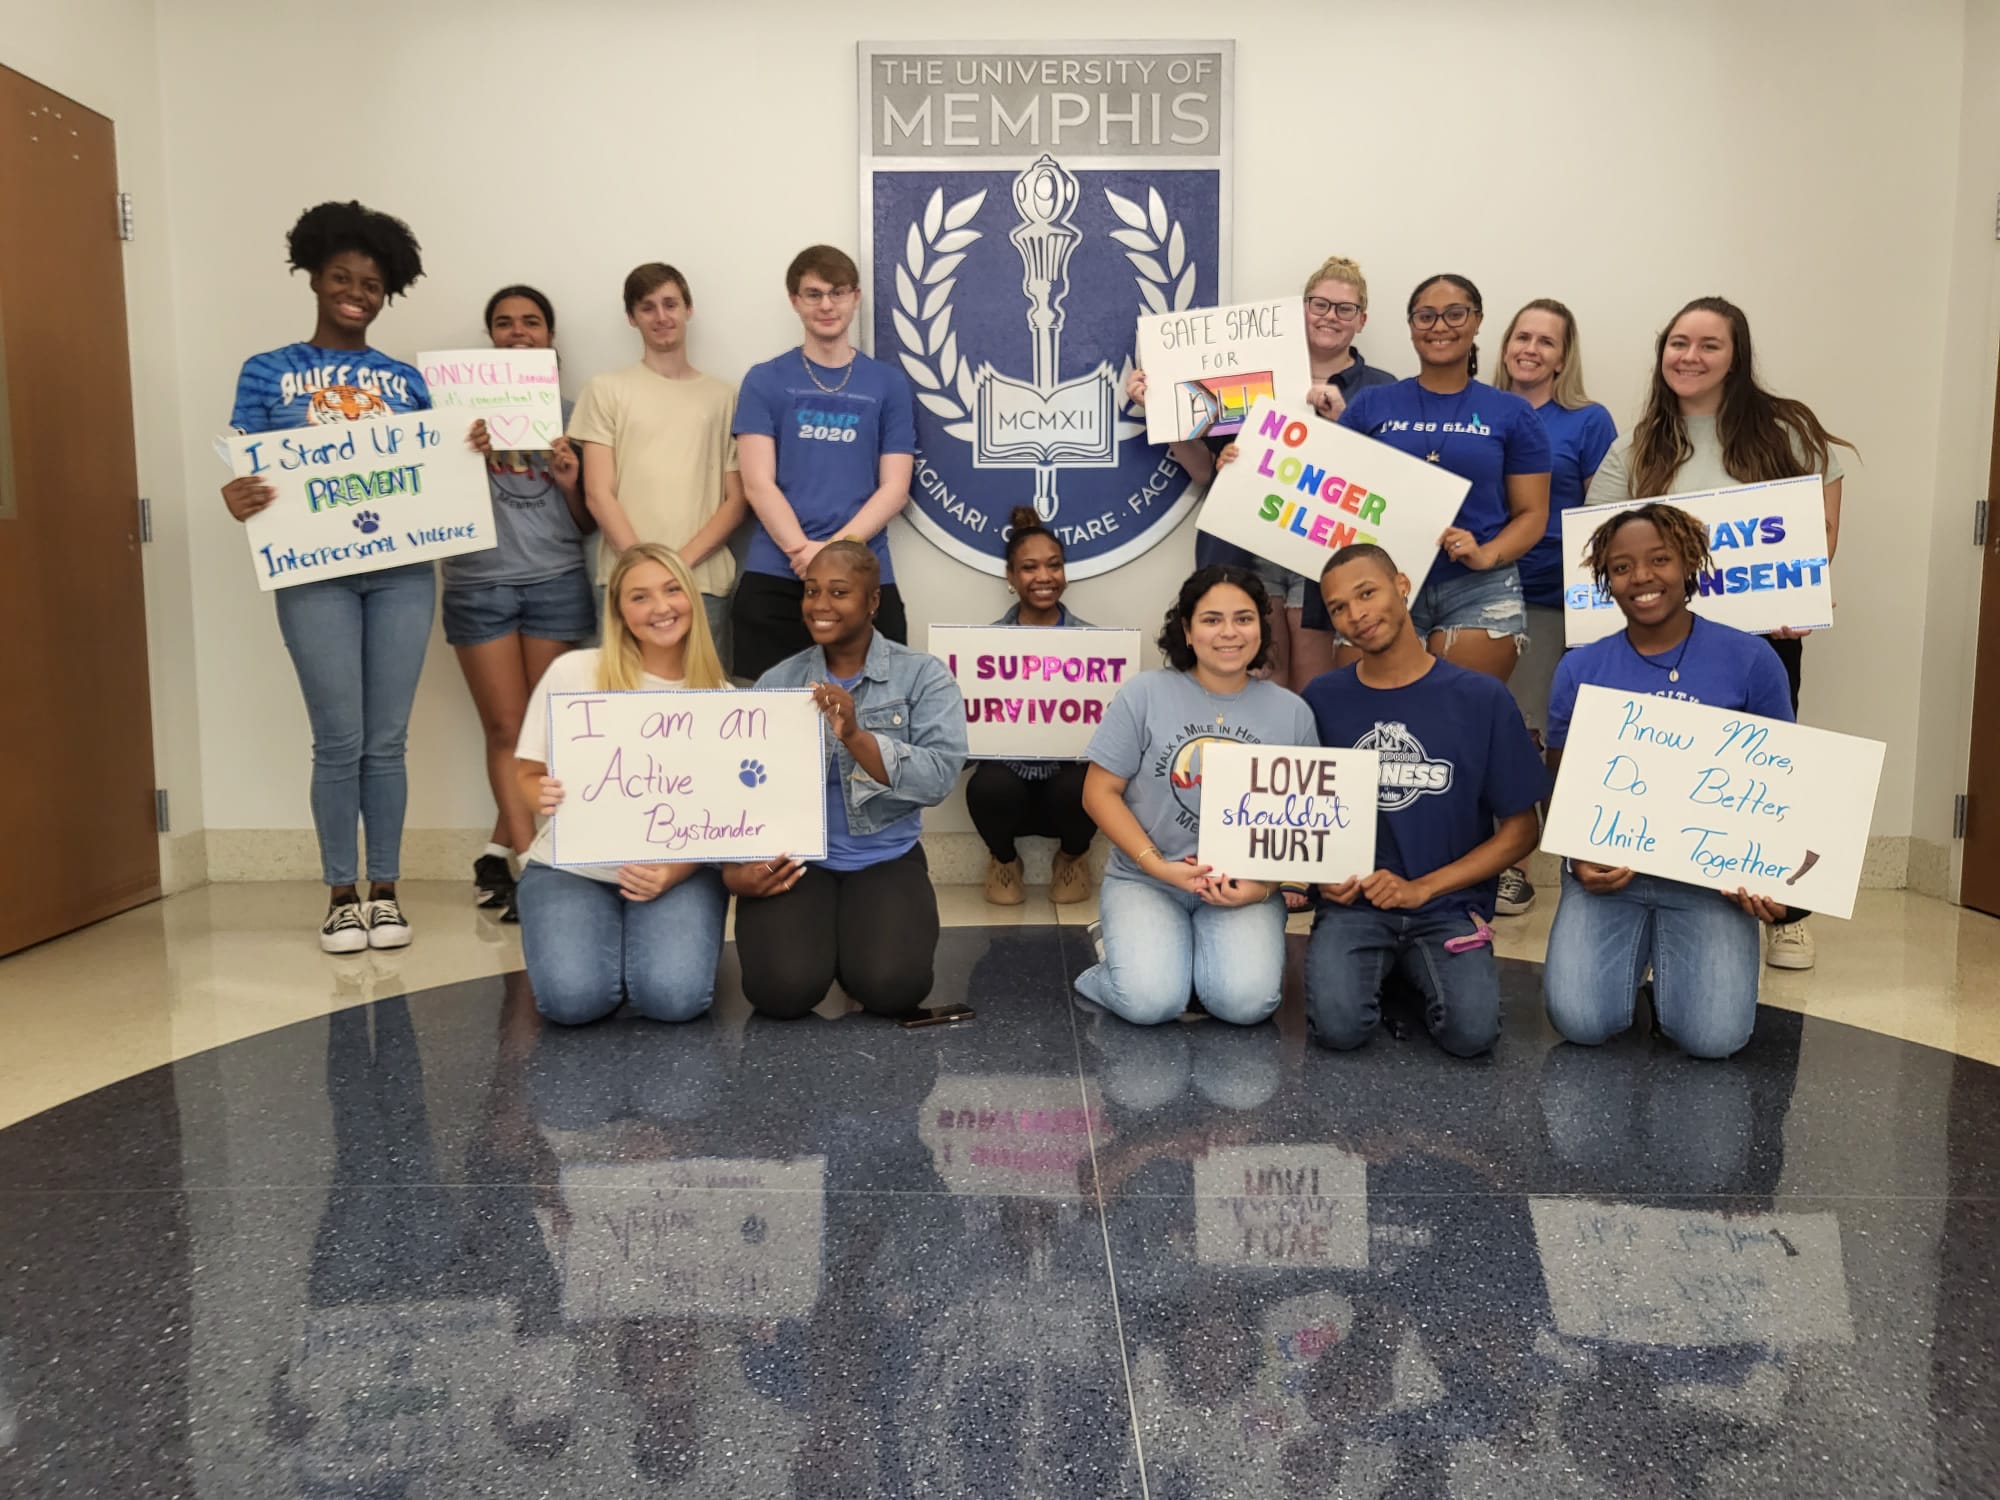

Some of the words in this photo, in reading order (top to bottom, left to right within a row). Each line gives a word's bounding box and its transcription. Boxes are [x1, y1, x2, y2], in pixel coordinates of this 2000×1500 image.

[880, 60, 943, 84] THE
[956, 60, 1154, 84] UNIVERSITY
[1168, 60, 1213, 83] OF
[883, 92, 1210, 146] MEMPHIS
[1160, 315, 1217, 350] SAFE
[1225, 305, 1283, 341] SPACE
[1201, 352, 1239, 369] FOR
[357, 366, 410, 404] CITY
[796, 408, 859, 428] CAMP
[798, 424, 857, 442] 2020
[999, 410, 1093, 430] MCMXII
[1258, 410, 1308, 448] NO
[1380, 420, 1409, 433] I'M
[1413, 422, 1437, 432] SO
[1443, 422, 1491, 436] GLAD
[245, 442, 270, 474] I
[280, 431, 355, 470] Stand
[416, 421, 440, 449] to
[304, 463, 424, 513] PREVENT
[914, 449, 988, 533] AGINARI
[1257, 448, 1387, 525] LONGER
[949, 654, 957, 678] I
[976, 655, 1127, 682] SUPPORT
[567, 699, 607, 741] I
[640, 711, 693, 740] am
[719, 706, 767, 740] an
[963, 698, 1112, 724] URVIVOR
[1617, 700, 1694, 750] Know
[1714, 719, 1794, 775] More,
[582, 747, 694, 802] Active
[1249, 756, 1337, 797] LOVE
[1602, 755, 1647, 796] Do
[1689, 767, 1791, 822] Better,
[643, 803, 766, 850] Bystander
[1222, 792, 1350, 829] shouldn't
[1589, 805, 1656, 852] Unite
[1248, 828, 1330, 862] HURT
